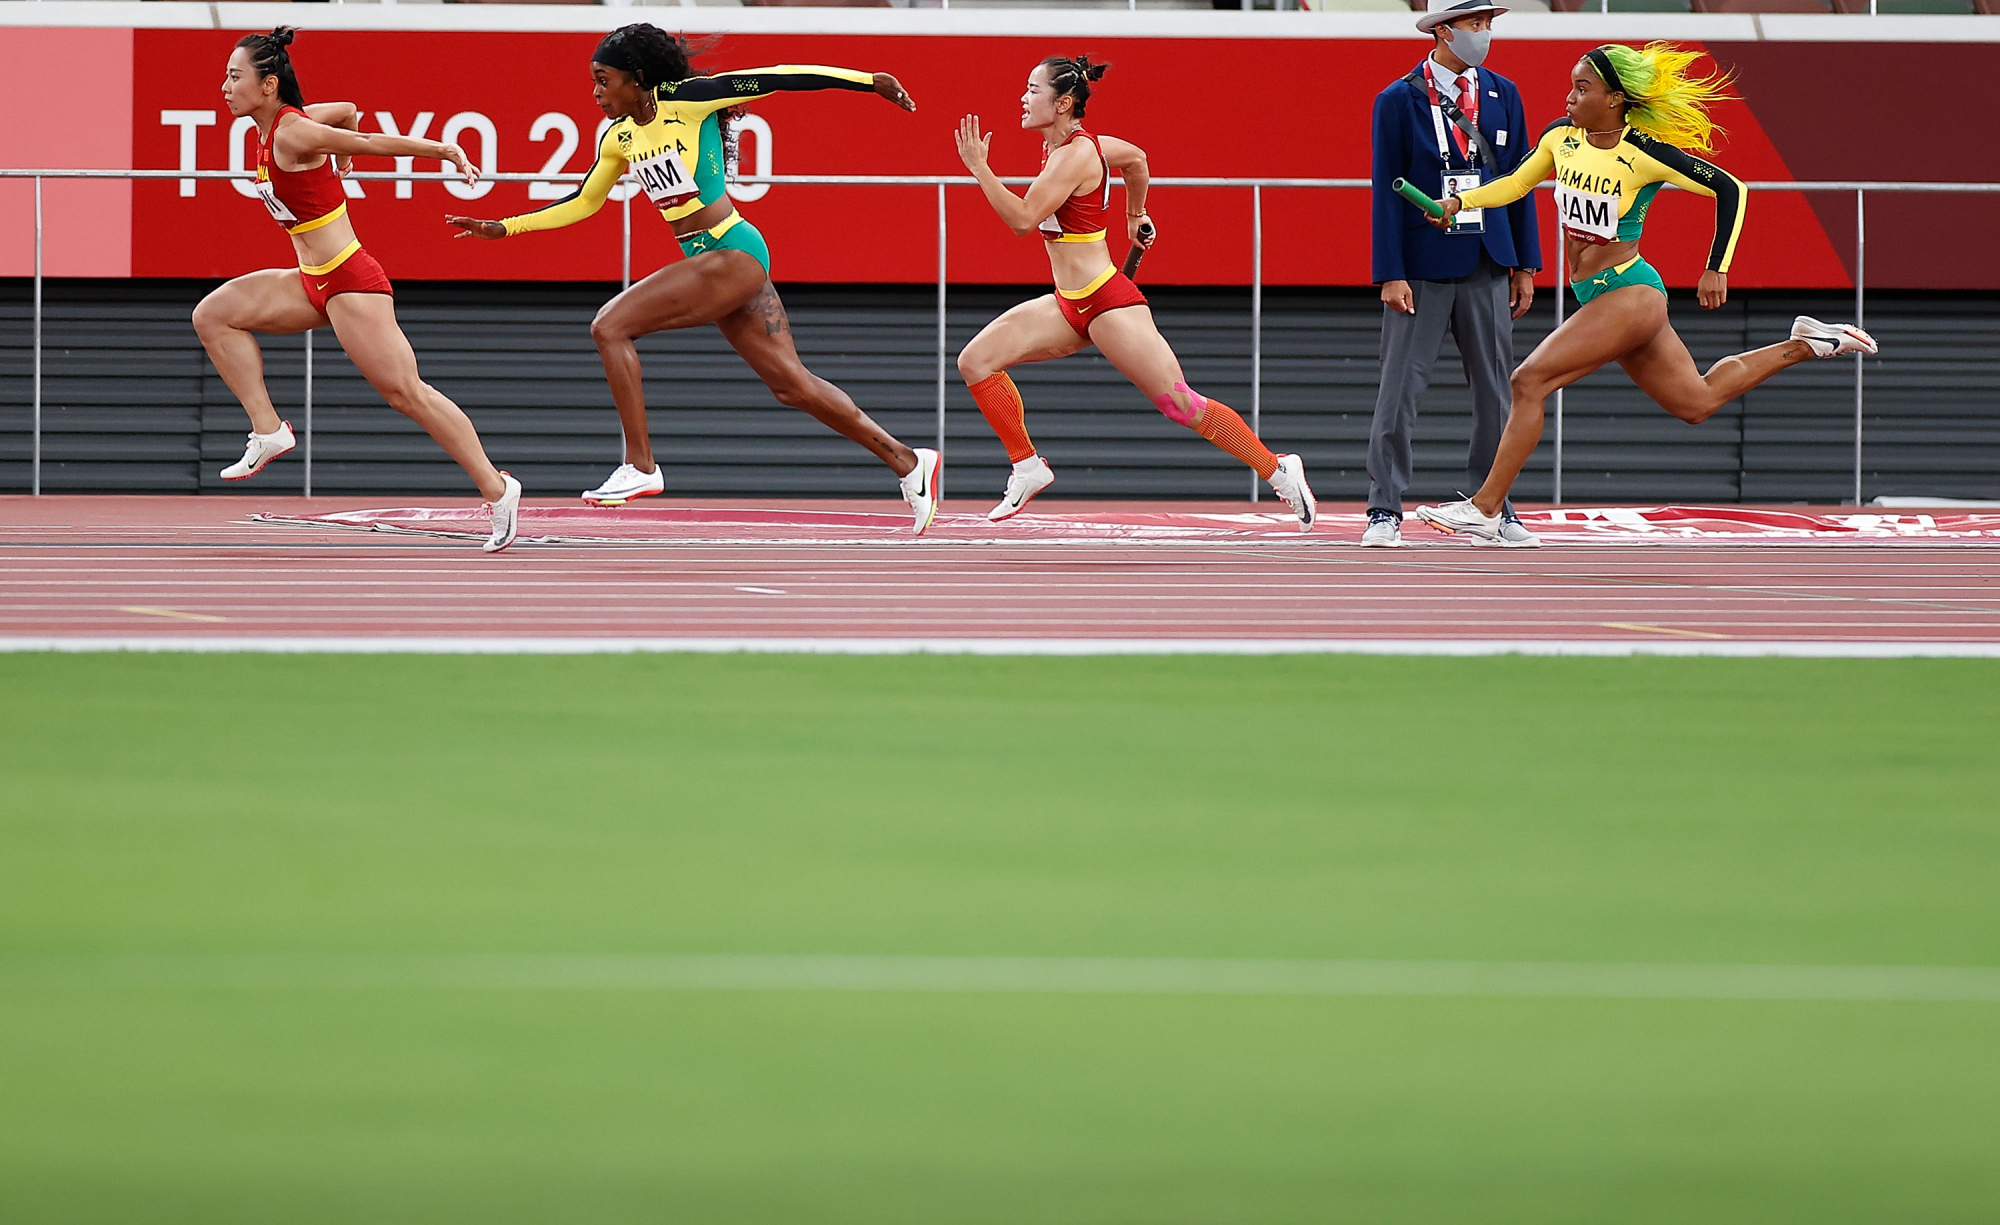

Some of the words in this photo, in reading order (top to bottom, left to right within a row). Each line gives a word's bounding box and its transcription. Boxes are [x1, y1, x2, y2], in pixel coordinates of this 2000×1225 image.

[161, 109, 498, 199] TOYO
[528, 112, 772, 202] 20
[636, 158, 683, 193] JAM
[1557, 165, 1622, 197] JAMAICA
[1563, 193, 1609, 227] JAM
